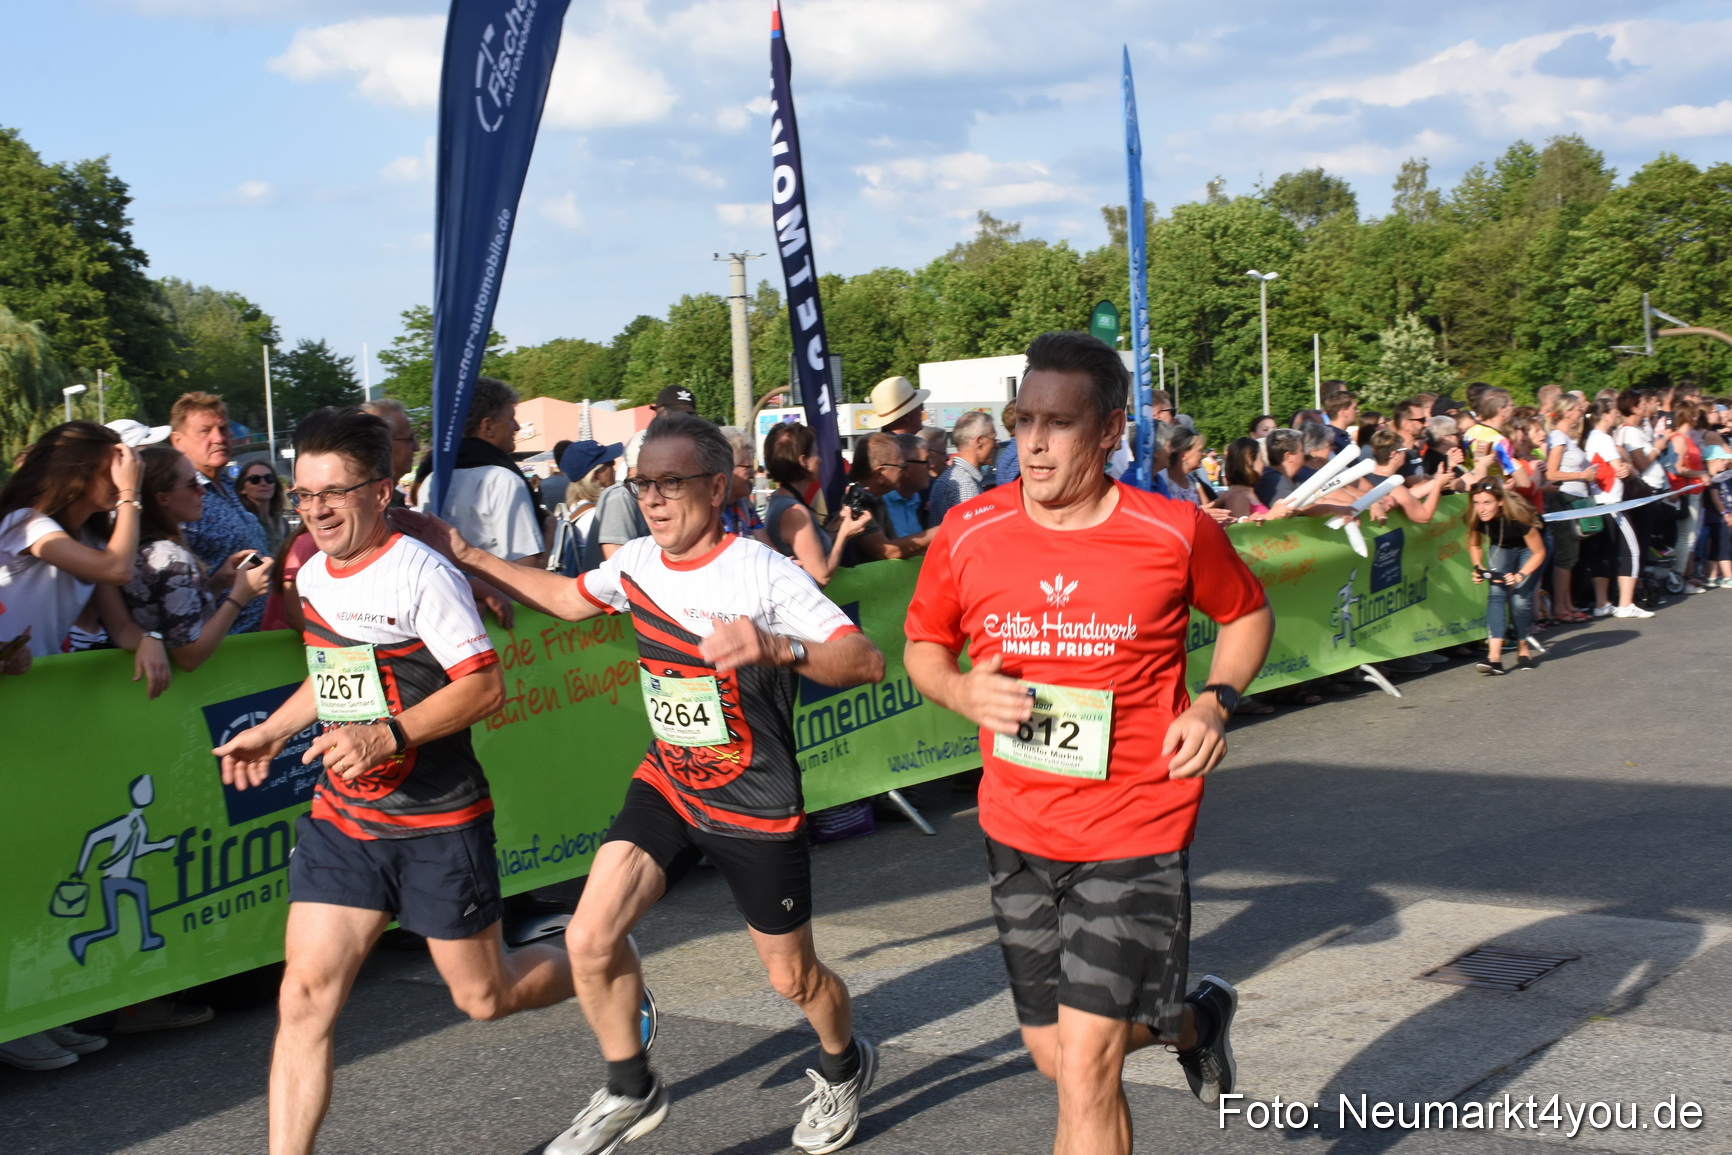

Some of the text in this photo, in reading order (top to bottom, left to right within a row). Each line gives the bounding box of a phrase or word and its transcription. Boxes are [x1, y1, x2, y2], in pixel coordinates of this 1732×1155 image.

[974, 504, 995, 516] JAKO
[336, 611, 385, 625] NEUMARKT
[983, 611, 1138, 641] Echtes Handwerk
[540, 618, 625, 660] Firmen
[1002, 640, 1116, 657] IMMER FRISCH
[317, 673, 365, 700] 2267
[563, 660, 641, 706] länger
[650, 697, 711, 728] 2264
[797, 676, 924, 751] rmenlau
[887, 727, 980, 773] www.firmenlau
[1012, 739, 1084, 763] Schuster Markus
[1016, 716, 1081, 751] 612
[173, 821, 290, 901] firm
[497, 815, 614, 877] lauf-ober
[183, 867, 290, 933] neumar
